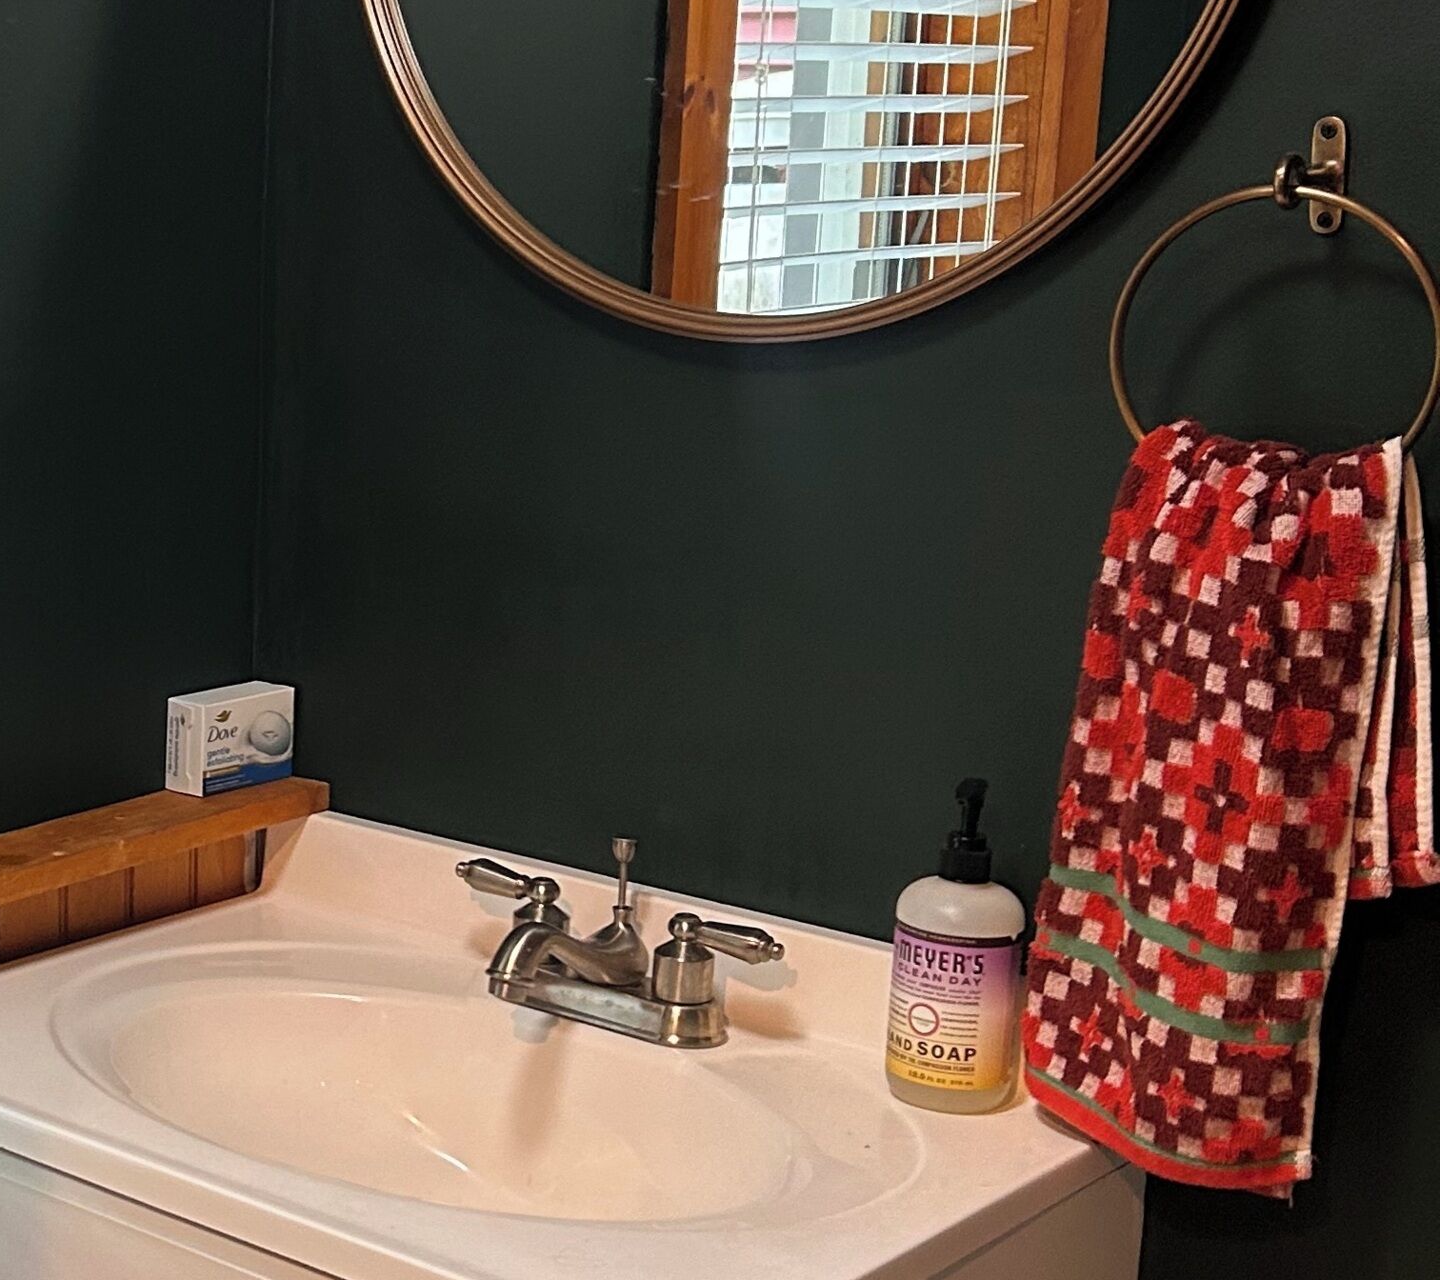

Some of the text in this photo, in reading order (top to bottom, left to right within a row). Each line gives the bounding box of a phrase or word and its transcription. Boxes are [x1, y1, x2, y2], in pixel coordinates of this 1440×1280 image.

[207, 725, 238, 743] Dove
[207, 747, 230, 760] gentle
[207, 754, 244, 767] exfoliating
[899, 939, 984, 974] MEYER'S
[898, 962, 942, 983] CLEAN
[948, 976, 982, 986] DAY
[888, 1030, 977, 1062] AND SOAP
